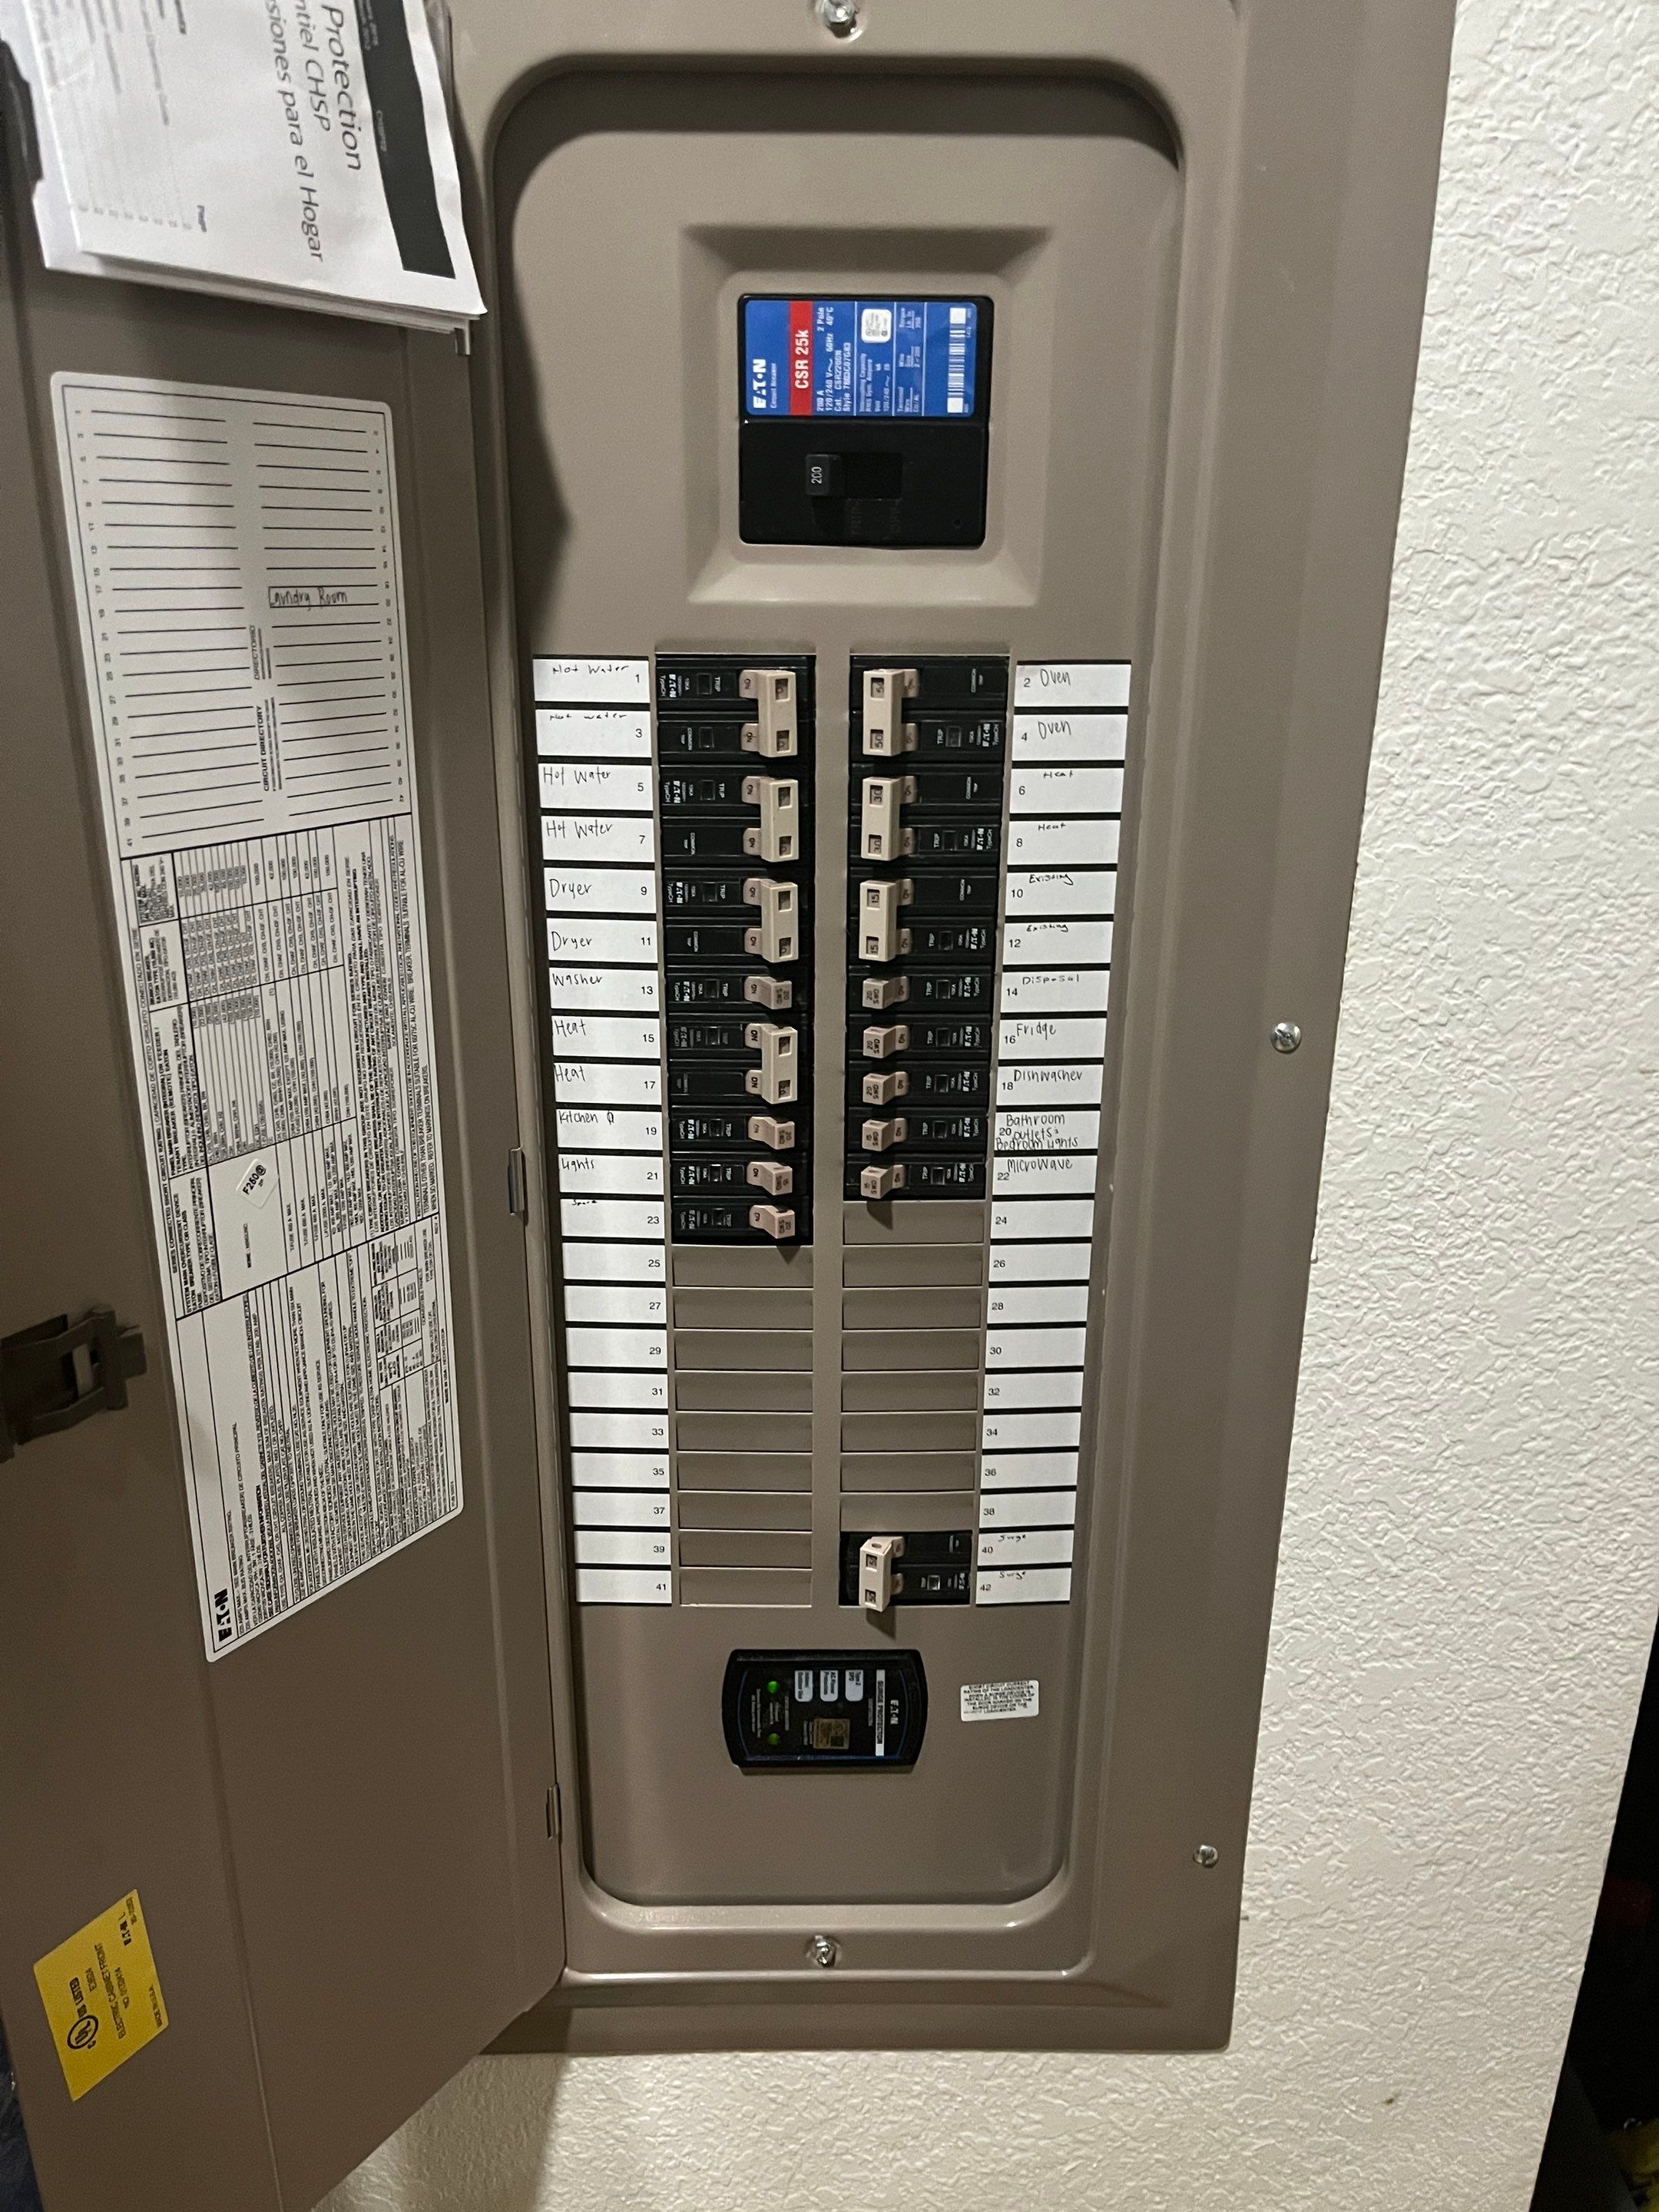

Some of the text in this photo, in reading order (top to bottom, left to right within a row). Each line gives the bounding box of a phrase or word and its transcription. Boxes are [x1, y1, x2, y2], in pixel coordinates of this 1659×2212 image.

[321, 5, 362, 171] Protection
[305, 60, 331, 131] CHSP
[278, 90, 304, 146] para
[295, 155, 315, 177] el
[300, 186, 323, 263] Hogar
[794, 329, 810, 389] CSR 25k
[753, 359, 767, 409] EATON
[811, 466, 823, 485] 200
[634, 674, 640, 683] 1
[1023, 677, 1031, 687] 2
[1040, 668, 1071, 687] Oven
[635, 728, 643, 738] 3
[1038, 720, 1071, 740] Oven
[1021, 732, 1028, 741] 4
[257, 706, 270, 792] CIRCUIT DIRECTORY
[543, 766, 611, 785] Hot Water
[637, 782, 644, 792] 5
[1018, 786, 1026, 795] 6
[546, 819, 612, 839] Hot Water
[639, 835, 646, 844] 7
[1016, 838, 1023, 847] 8
[549, 879, 592, 899] Dryer
[641, 886, 647, 896] 9
[1012, 889, 1023, 898] 10
[551, 931, 593, 951] Dryer
[641, 936, 651, 946] 11
[1009, 939, 1022, 948] 12
[552, 973, 602, 986] Washer
[641, 985, 654, 995] 13
[1006, 988, 1018, 996] 14
[554, 1018, 586, 1037] Heat
[1016, 1022, 1057, 1040] Fridge
[642, 1034, 654, 1043] 15
[1004, 1035, 1016, 1044] 16
[554, 1064, 585, 1082] Heat
[644, 1081, 656, 1089] 17
[1002, 1082, 1014, 1091] 18
[1006, 1114, 1065, 1127] Bathroom
[646, 1127, 657, 1135] 19
[999, 1128, 1012, 1136] 20
[561, 1157, 594, 1172] Lights
[647, 1172, 658, 1181] 21
[997, 1172, 1010, 1181] 22
[647, 1216, 660, 1224] 23
[995, 1217, 1007, 1225] 24
[648, 1260, 661, 1268] 25
[993, 1260, 1006, 1268] 26
[649, 1302, 661, 1310] 27
[992, 1302, 1004, 1310] 28
[649, 1347, 661, 1356] 29
[989, 1346, 1002, 1355] 30
[651, 1388, 663, 1396] 31
[988, 1388, 1000, 1396] 32
[651, 1428, 664, 1436] 33
[653, 1468, 665, 1476] 35
[653, 1545, 665, 1554] 39
[656, 1583, 667, 1591] 41
[214, 1588, 232, 1642] EATON
